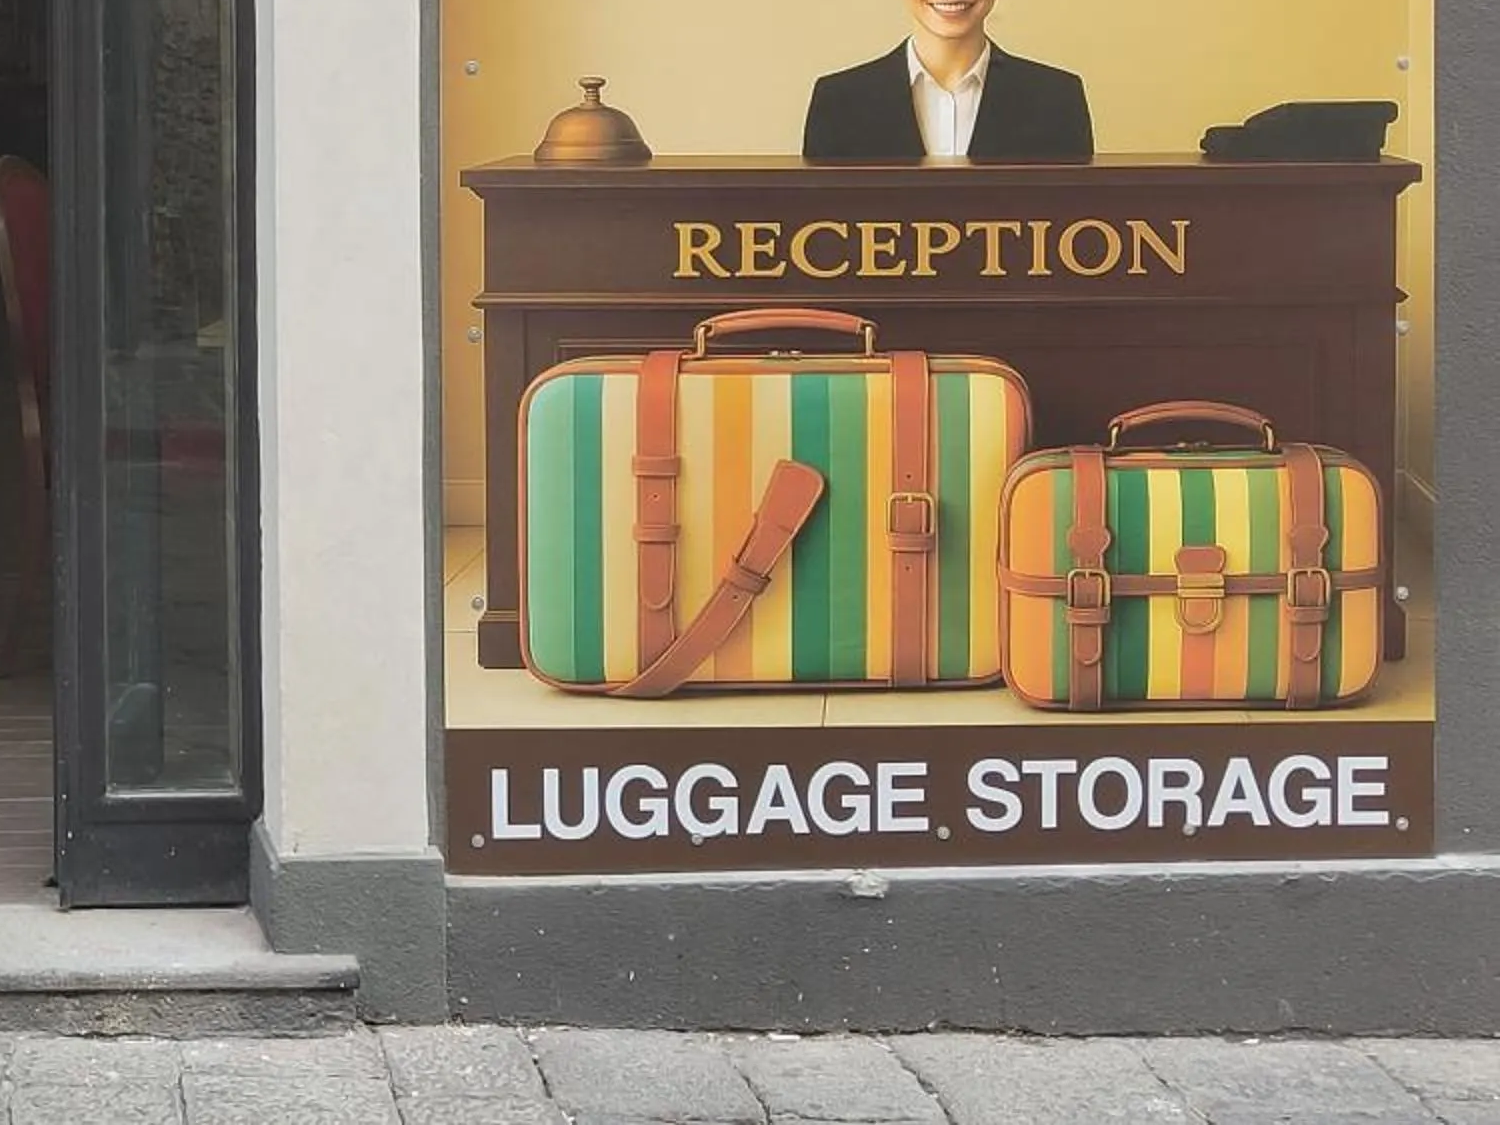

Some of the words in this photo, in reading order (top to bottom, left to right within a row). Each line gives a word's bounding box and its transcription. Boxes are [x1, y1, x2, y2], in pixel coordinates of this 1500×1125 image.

[672, 219, 1192, 279] RECEPTION
[490, 760, 930, 841] LUGGAGE
[965, 754, 1390, 833] STORAGE
